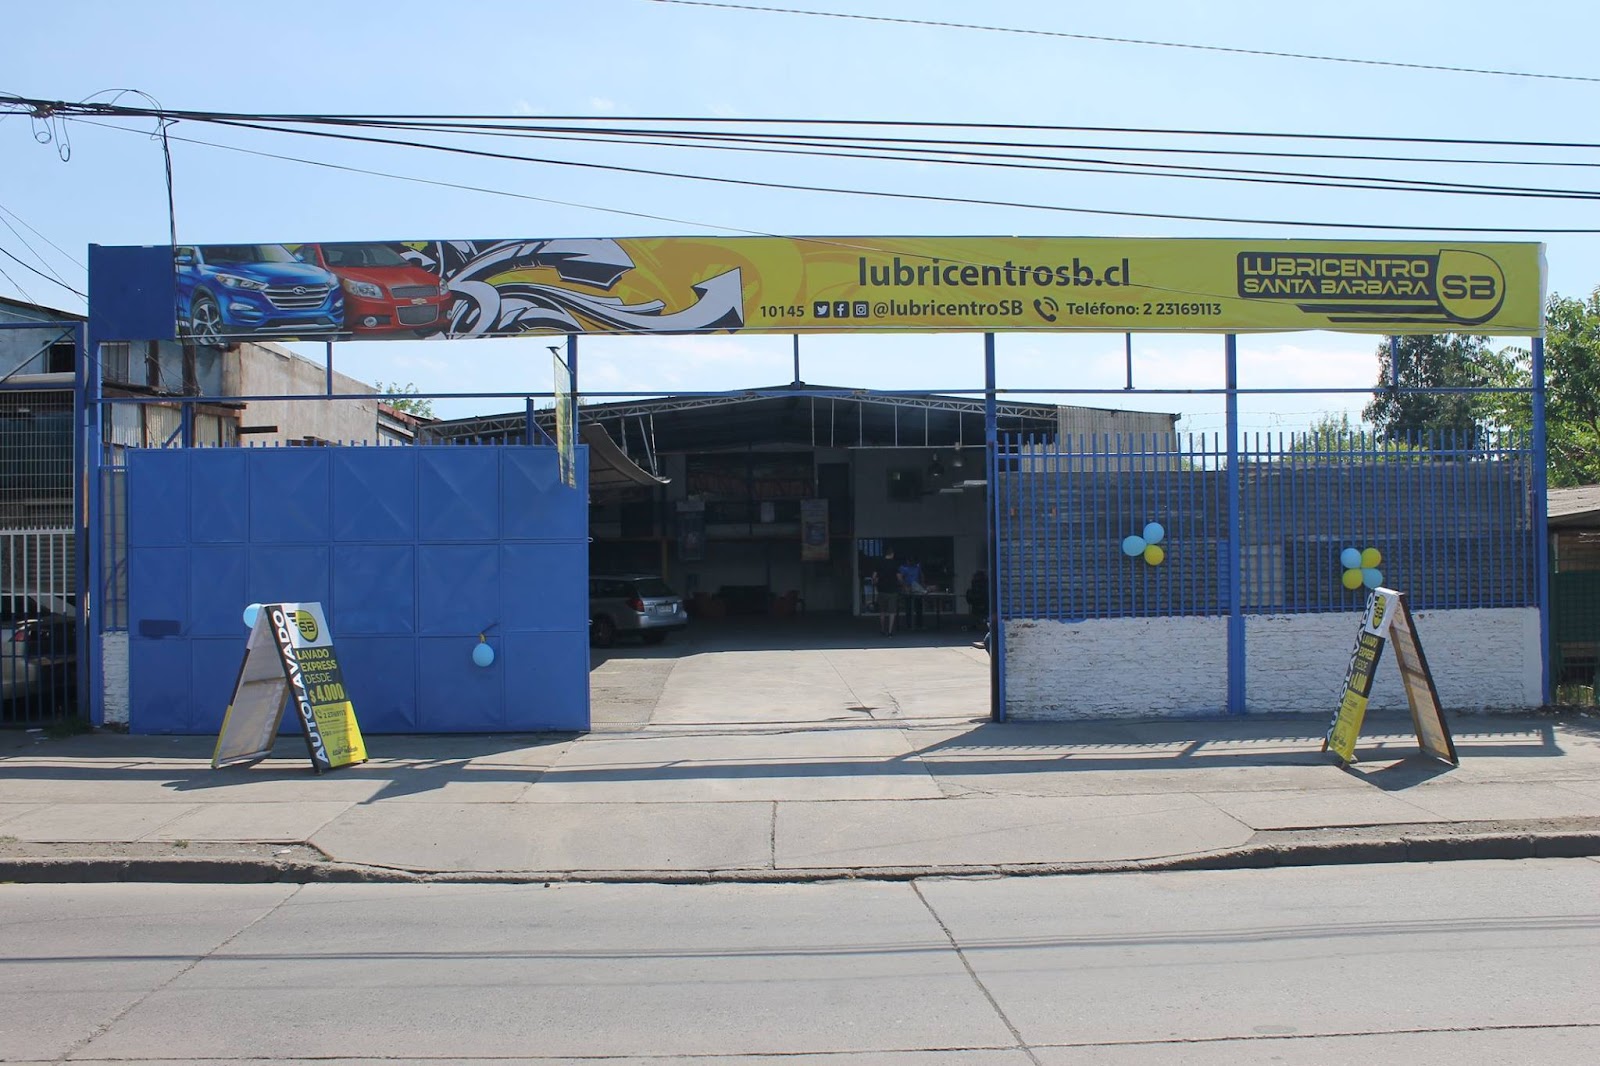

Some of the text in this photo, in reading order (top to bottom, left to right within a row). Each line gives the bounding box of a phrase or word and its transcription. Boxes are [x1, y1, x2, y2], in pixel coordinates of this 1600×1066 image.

[858, 256, 1131, 288] lubricentrosb.cl
[1243, 257, 1430, 278] LUBRICENTRO
[1243, 278, 1430, 296] SANTA BARBARA
[1442, 275, 1496, 300] SB
[759, 305, 805, 318] 10145
[873, 299, 1024, 320] @lubricentroSB
[1066, 301, 1140, 316] Teléfono:
[1155, 302, 1222, 316] 23169113
[299, 620, 316, 634] SB
[296, 648, 330, 661] LAVADO
[301, 659, 337, 672] EXPRESS
[305, 672, 333, 684] DESDE
[272, 609, 329, 764] AUTOLAVADO
